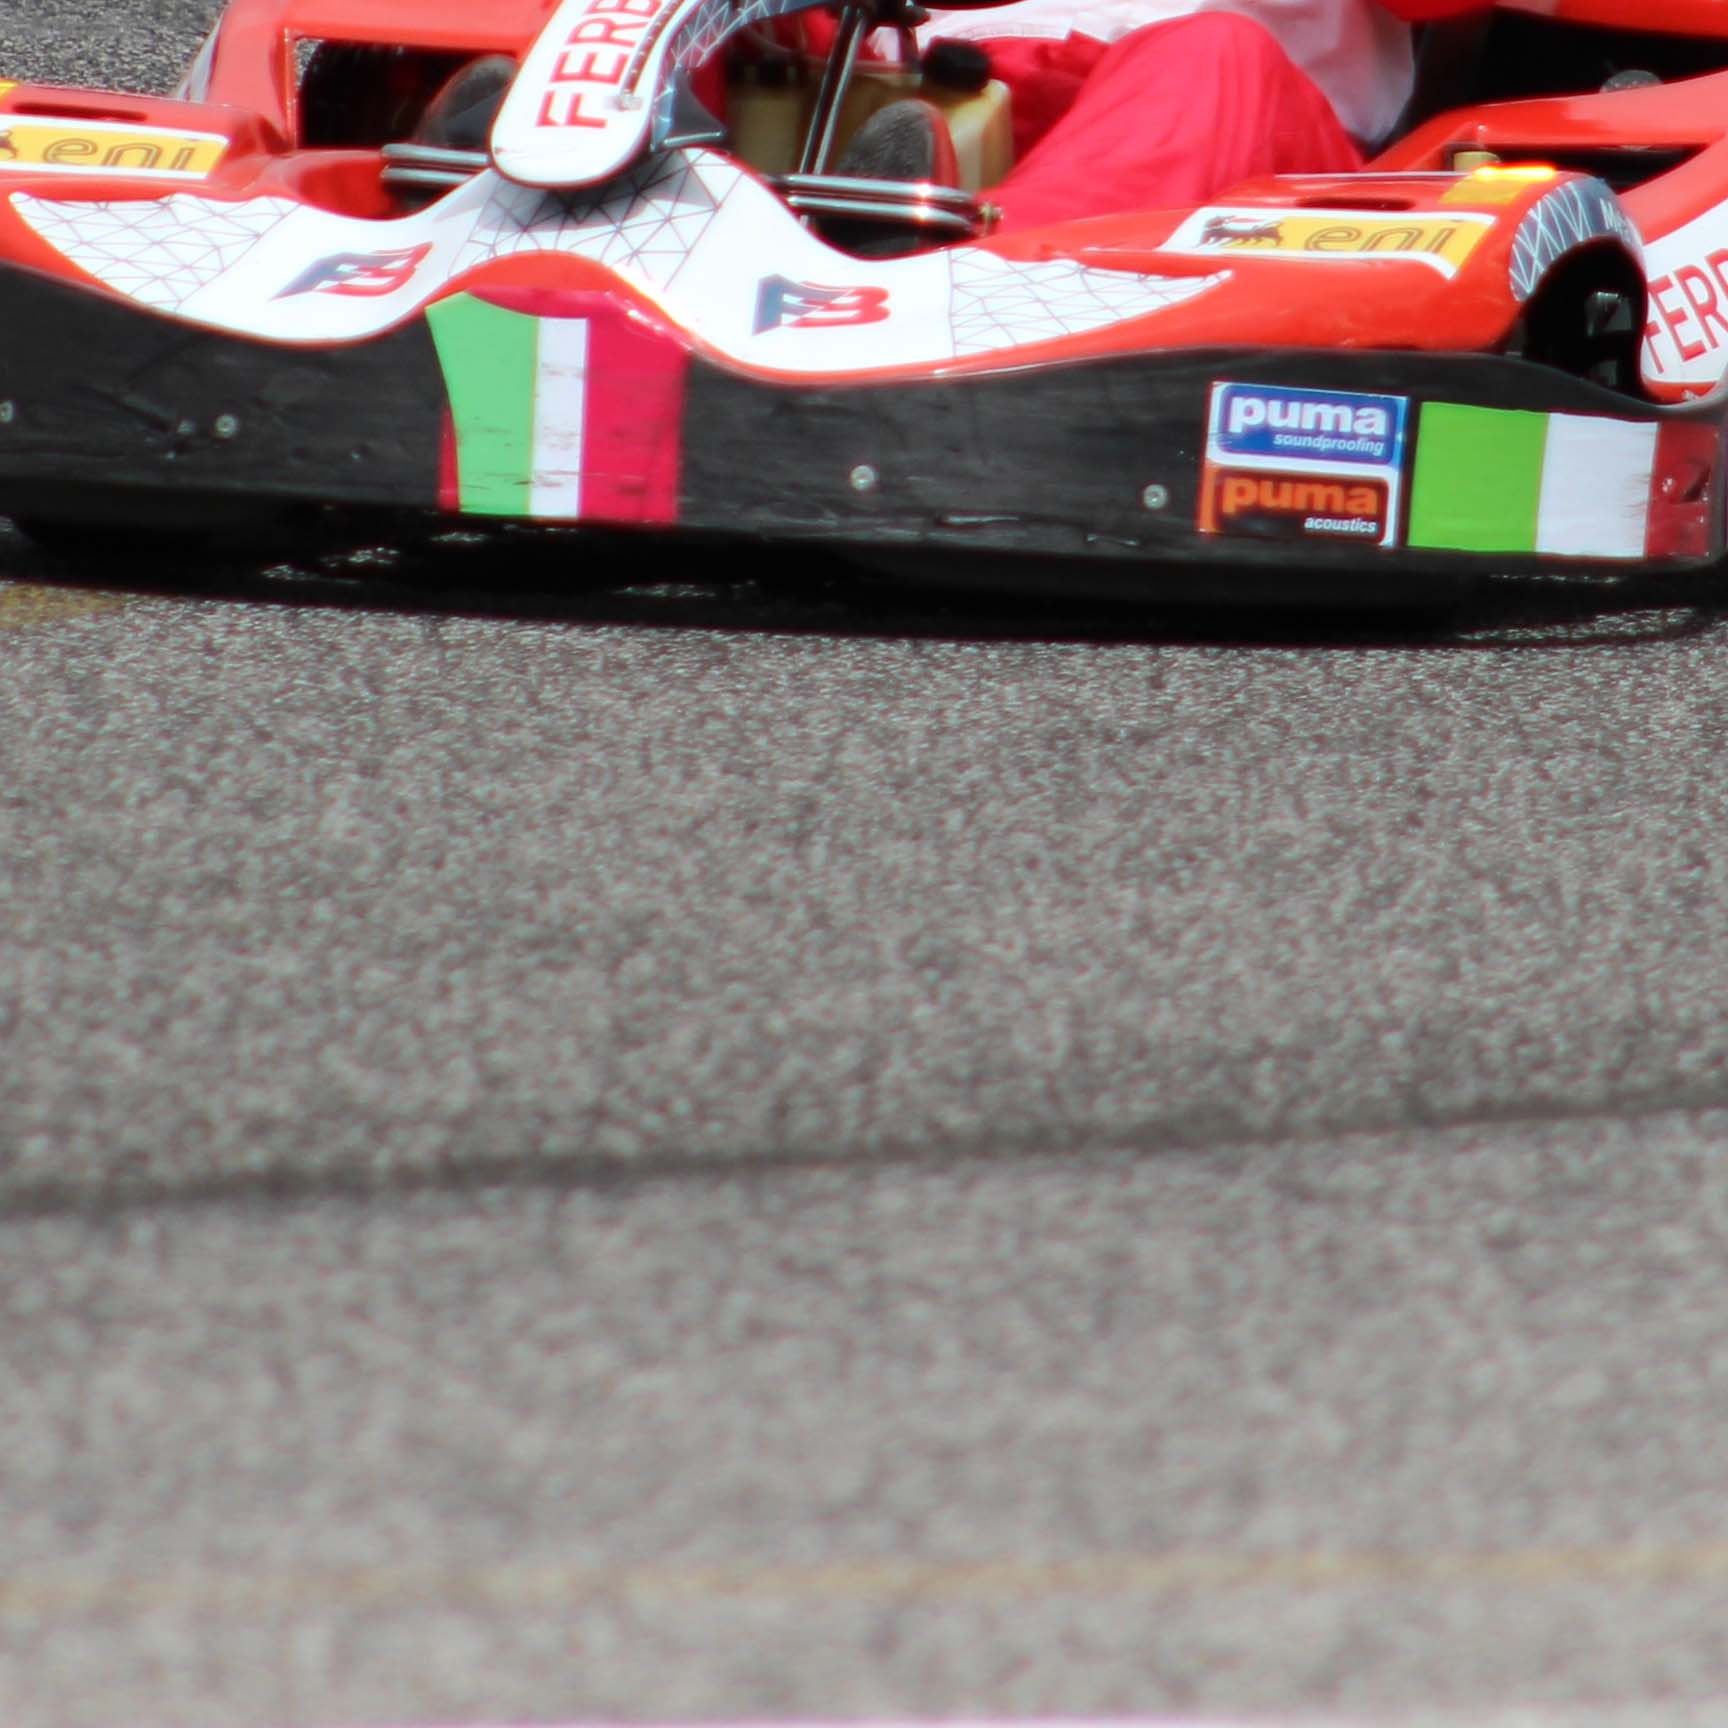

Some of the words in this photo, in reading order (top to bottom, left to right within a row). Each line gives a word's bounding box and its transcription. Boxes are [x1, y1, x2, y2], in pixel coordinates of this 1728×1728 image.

[41, 135, 205, 171] eni
[1303, 218, 1466, 257] eni
[1228, 396, 1388, 435] puma
[1273, 432, 1386, 456] soundproofing
[1222, 476, 1378, 518] puma
[1304, 516, 1378, 533] acoustics
